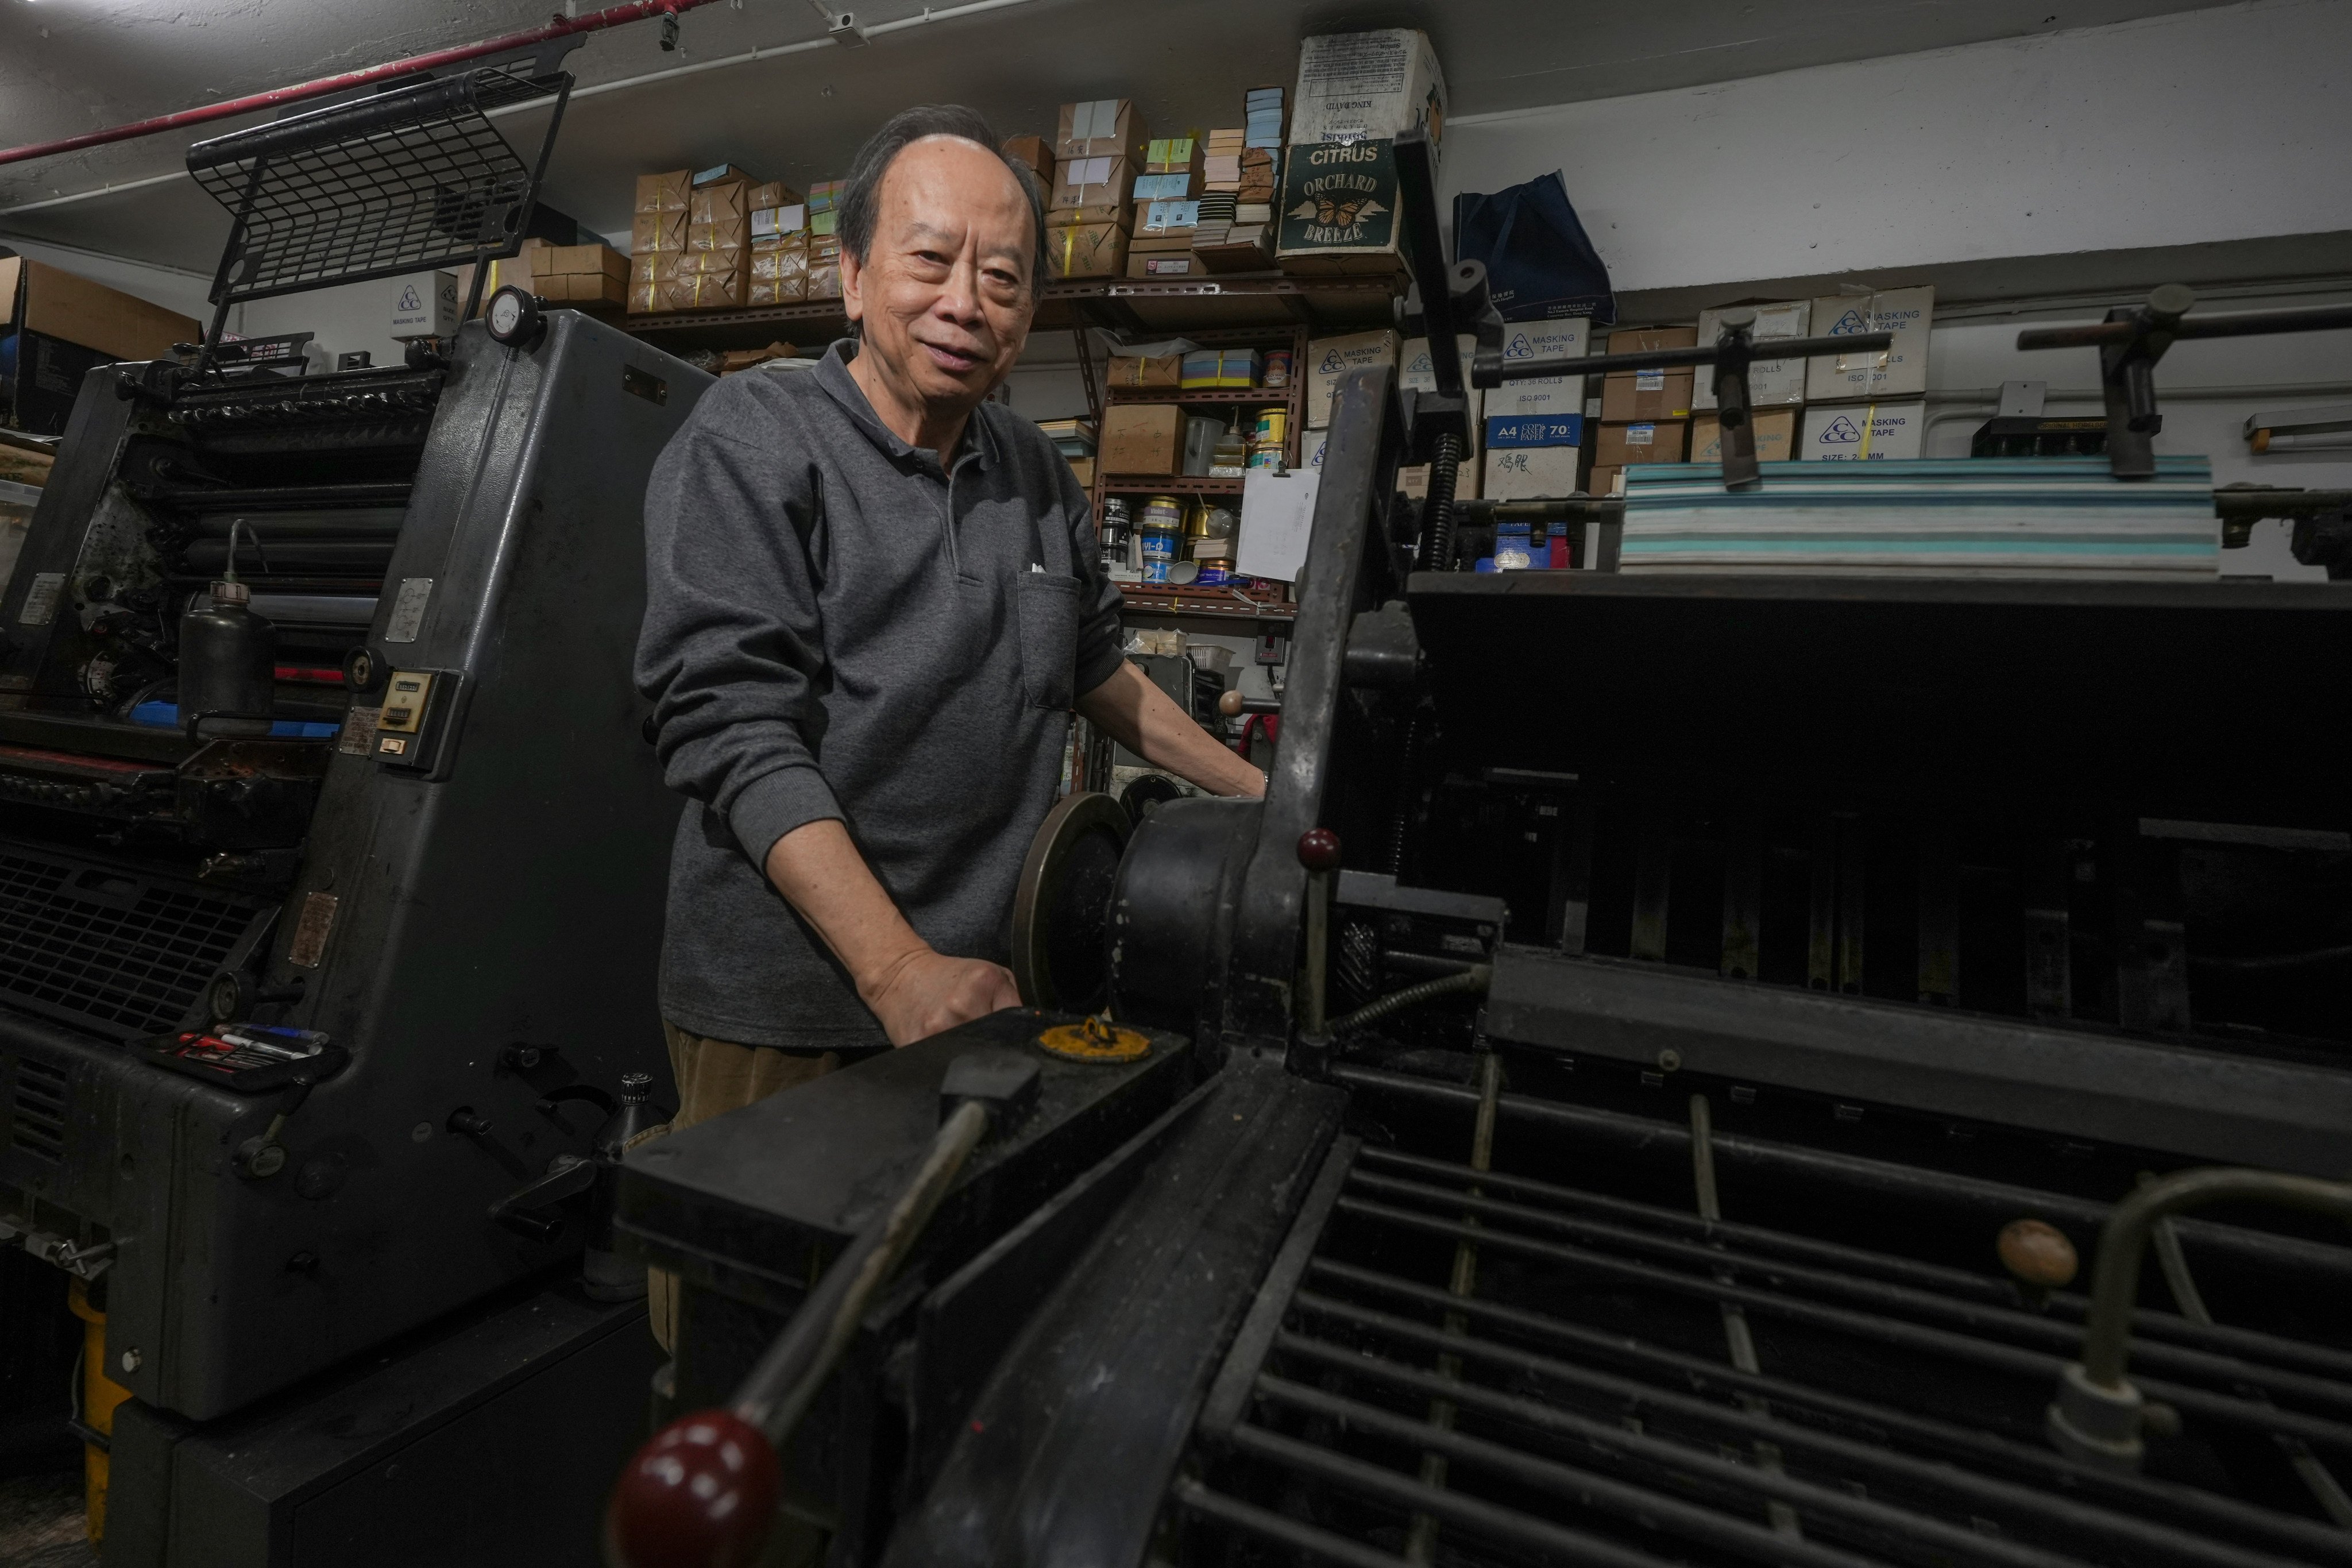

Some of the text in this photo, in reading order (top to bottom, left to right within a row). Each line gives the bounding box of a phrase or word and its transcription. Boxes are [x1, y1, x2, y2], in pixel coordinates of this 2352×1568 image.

[1326, 101, 1372, 110] KING DAVID
[1311, 147, 1377, 165] CITRUS
[1304, 173, 1377, 196] ORCHARD
[1303, 222, 1362, 244] BREEZE
[1878, 322, 1906, 330] TAPE
[1533, 334, 1574, 344] MASKING
[1344, 347, 1381, 358] MASKING
[1542, 345, 1565, 353] TAPE
[1353, 357, 1373, 365] TAPE
[1498, 427, 1517, 436] A4
[1550, 425, 1567, 435] 70
